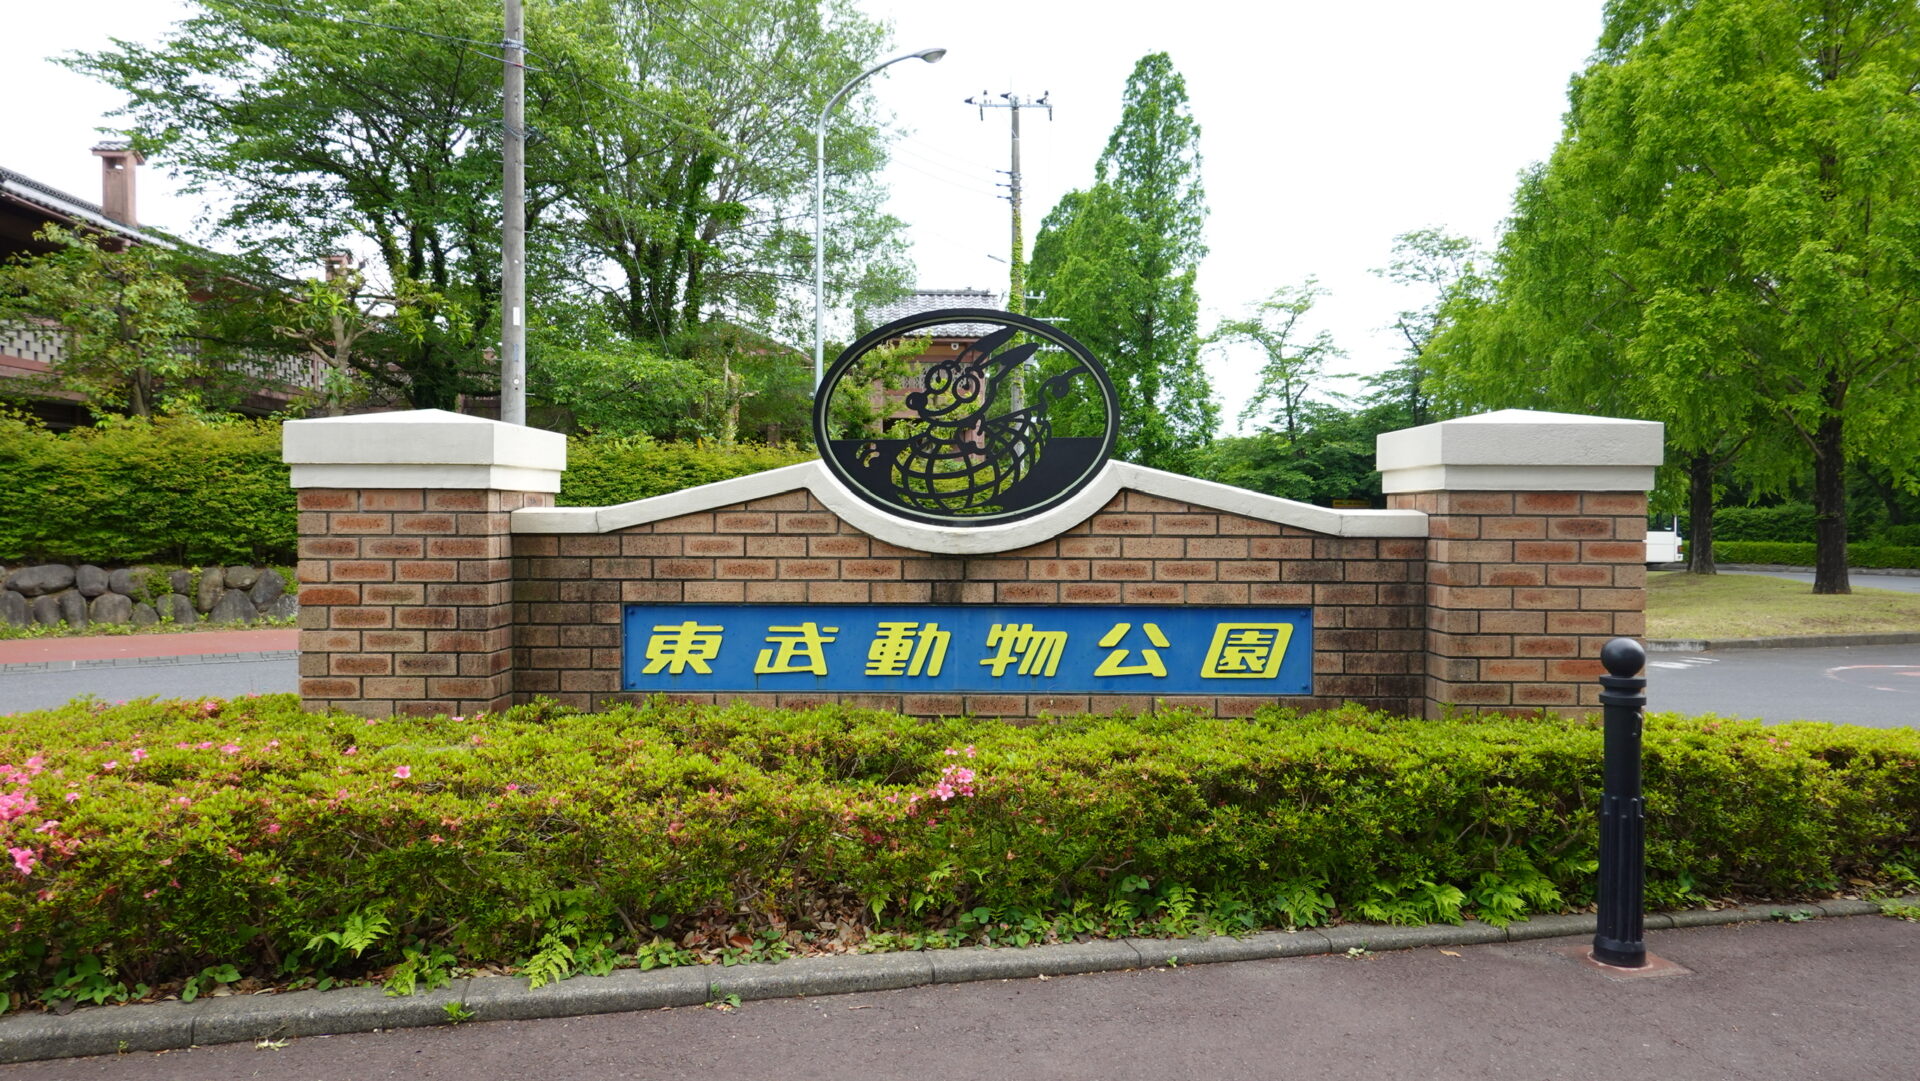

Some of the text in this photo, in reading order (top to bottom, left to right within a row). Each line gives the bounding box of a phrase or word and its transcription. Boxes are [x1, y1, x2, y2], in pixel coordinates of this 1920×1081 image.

[642, 621, 1294, 679] 東武動物公園
